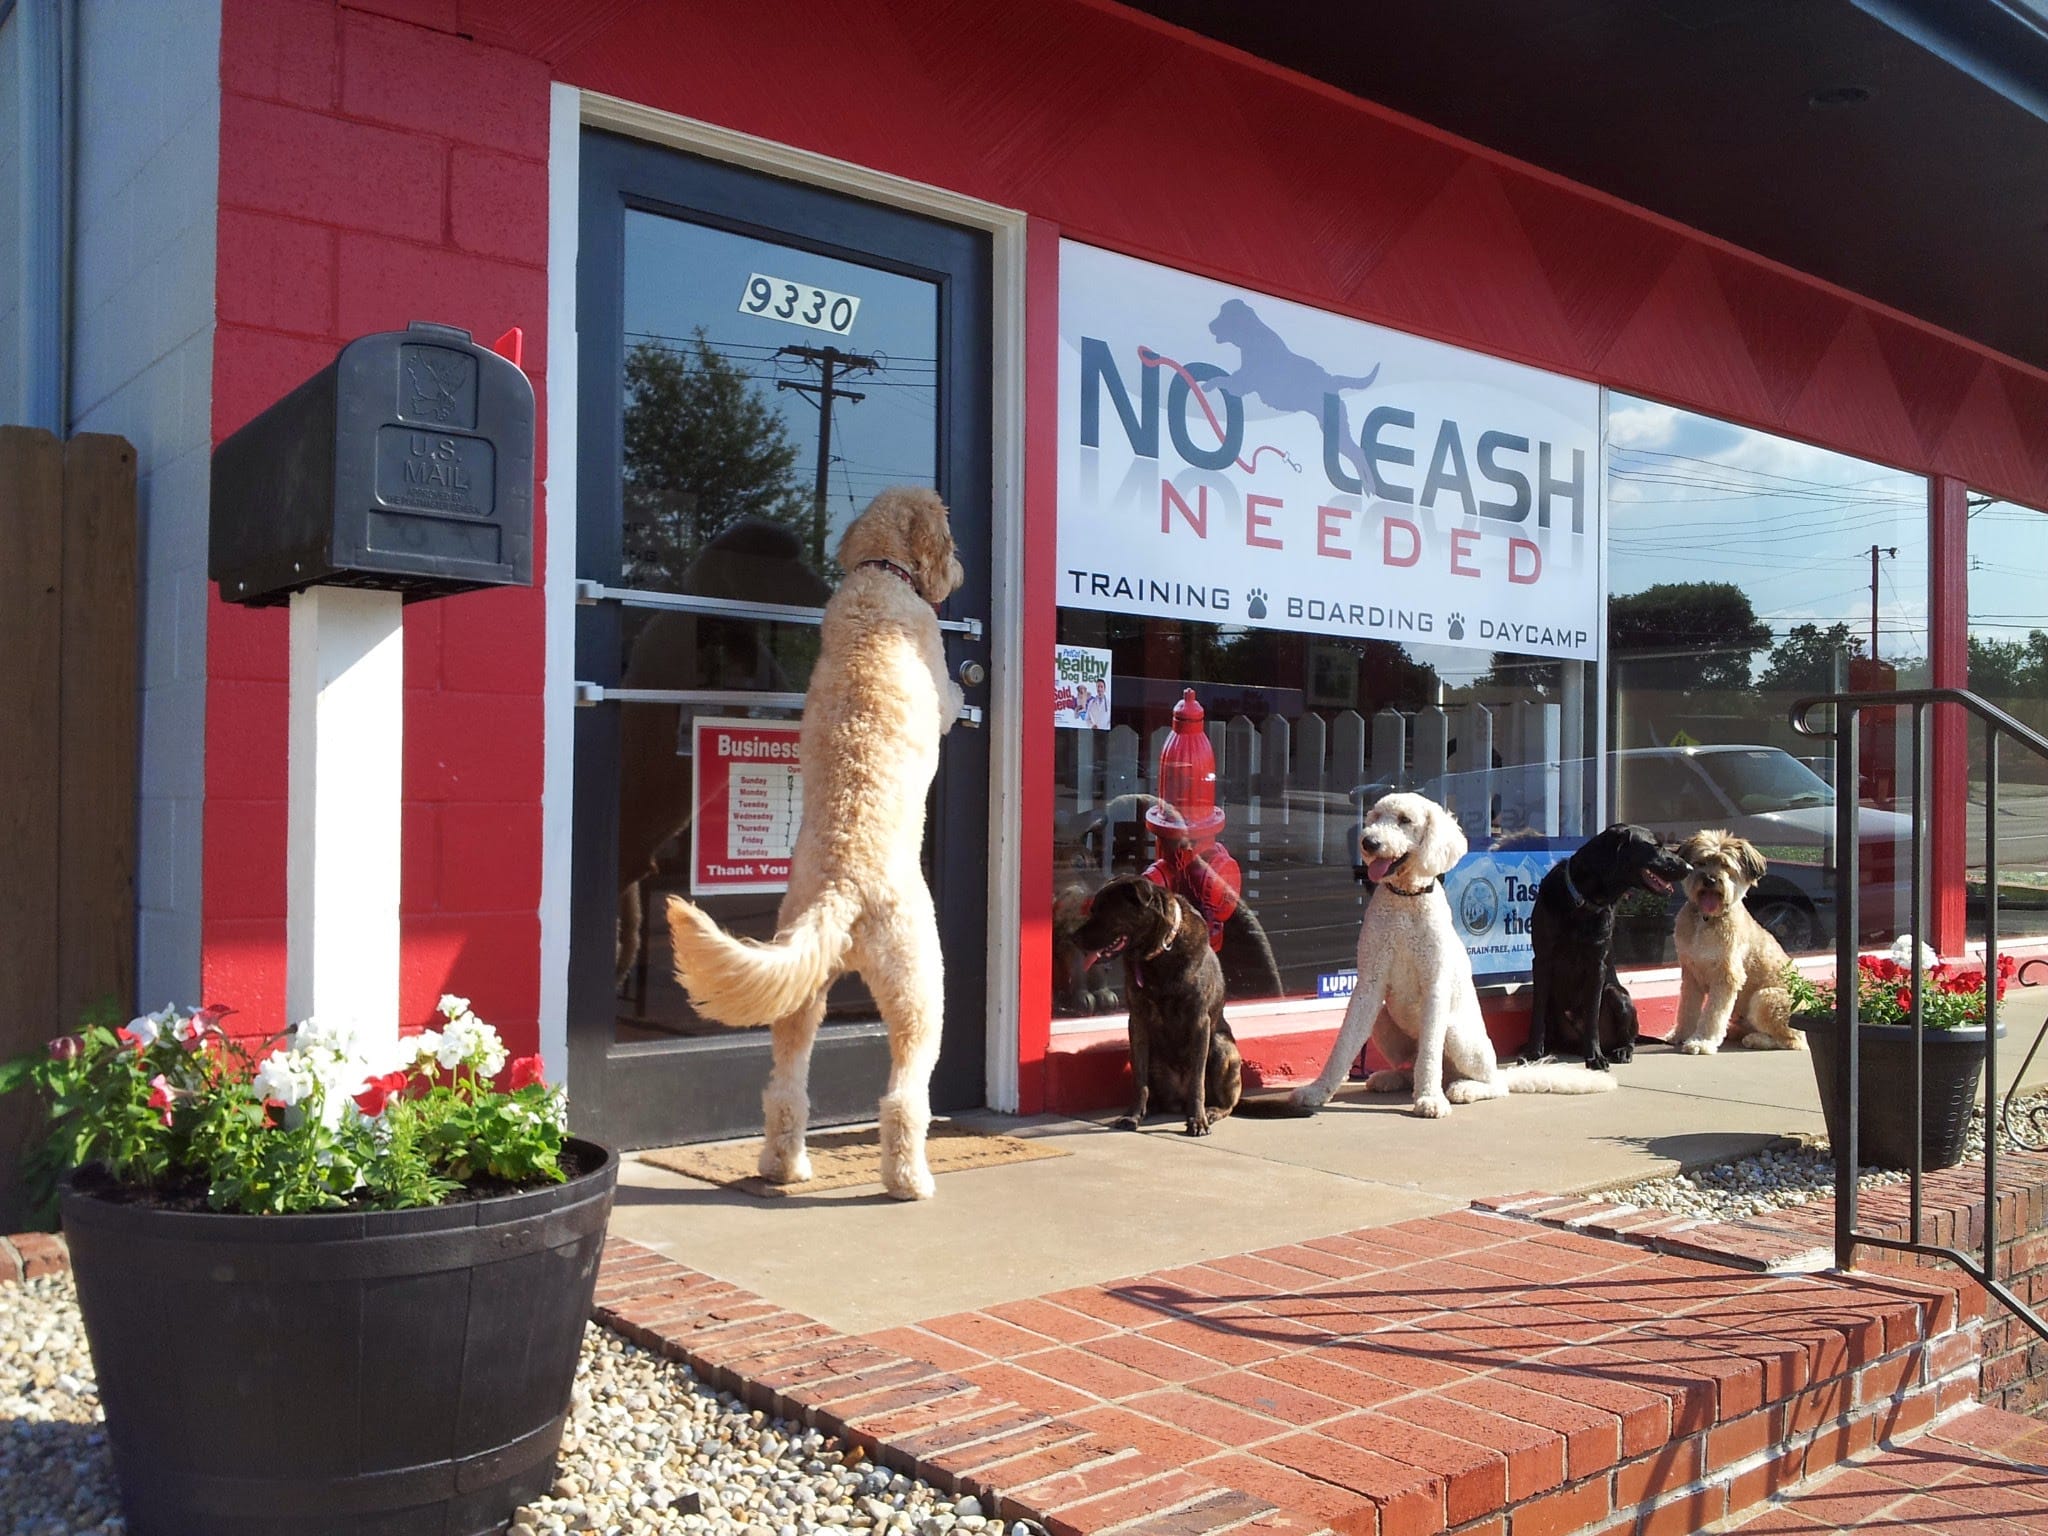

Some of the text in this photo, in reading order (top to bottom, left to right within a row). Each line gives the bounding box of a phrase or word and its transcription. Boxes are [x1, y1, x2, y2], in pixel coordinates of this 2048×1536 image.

[746, 277, 852, 331] 9330
[1080, 336, 1585, 535] NO LEASH
[409, 434, 463, 463] U.S.
[403, 460, 469, 489] MAIL
[1161, 478, 1542, 585] NEEDED
[1068, 569, 1588, 649] TRAINING BOARDING DAYCAMP
[1061, 670, 1080, 684] Dog
[718, 734, 801, 759] Business
[740, 776, 767, 785] Sunday
[739, 788, 768, 797] Monday
[738, 800, 769, 809] Tuesday
[733, 813, 774, 821] Wednesday
[736, 824, 770, 833] Thursday
[741, 836, 764, 845] Friday
[736, 848, 769, 857] Saturday
[706, 864, 788, 876] Thank You
[1504, 876, 1541, 902] Tas
[1511, 943, 1527, 953] ALL
